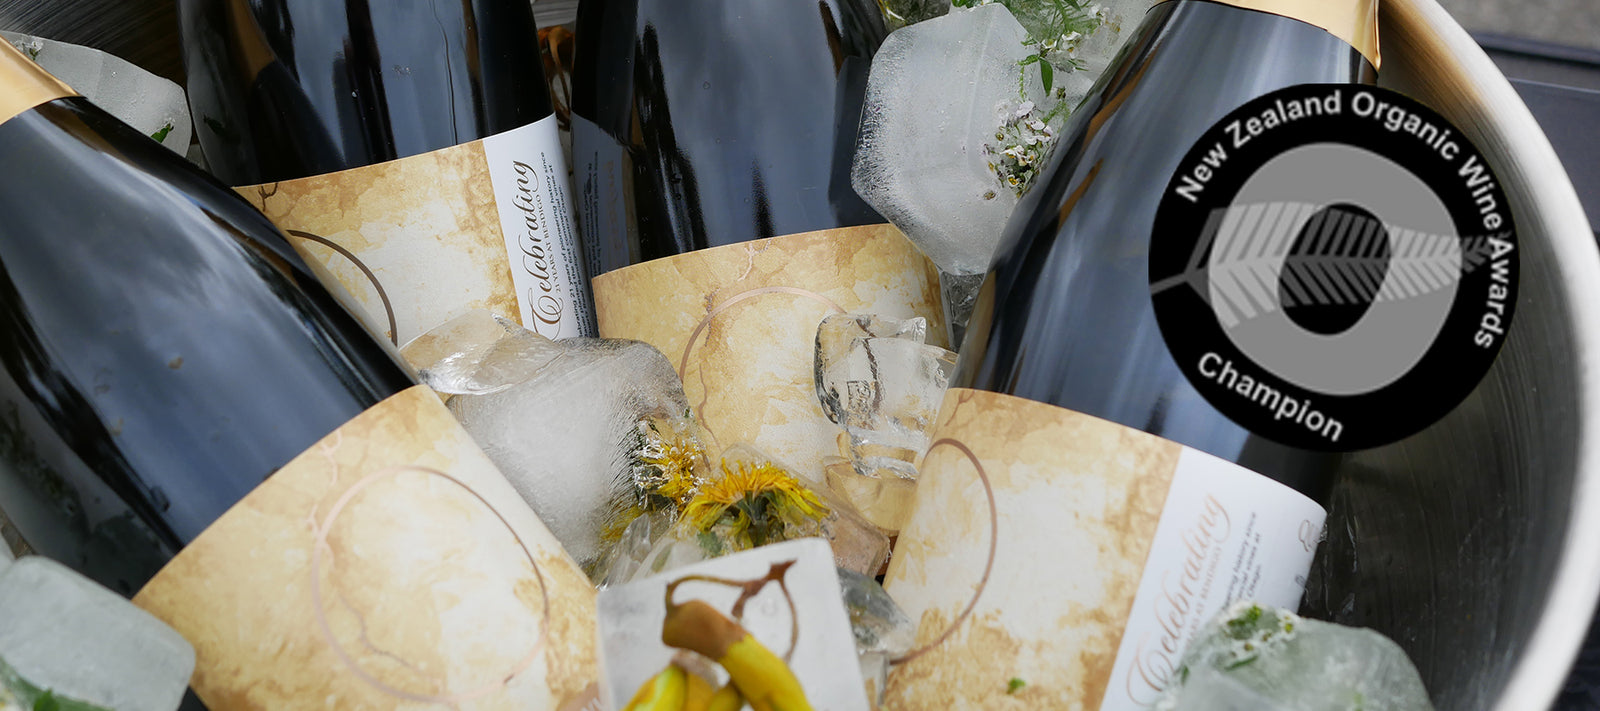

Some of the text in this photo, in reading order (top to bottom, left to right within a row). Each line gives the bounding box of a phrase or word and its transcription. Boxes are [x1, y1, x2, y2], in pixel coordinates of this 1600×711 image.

[546, 175, 555, 204] history
[511, 159, 563, 341] Celebrating
[536, 194, 561, 293] 21 YEARS AT BENDIGO
[552, 206, 566, 251] pioneering
[565, 264, 574, 286] years
[1126, 491, 1231, 707] Celebrating
